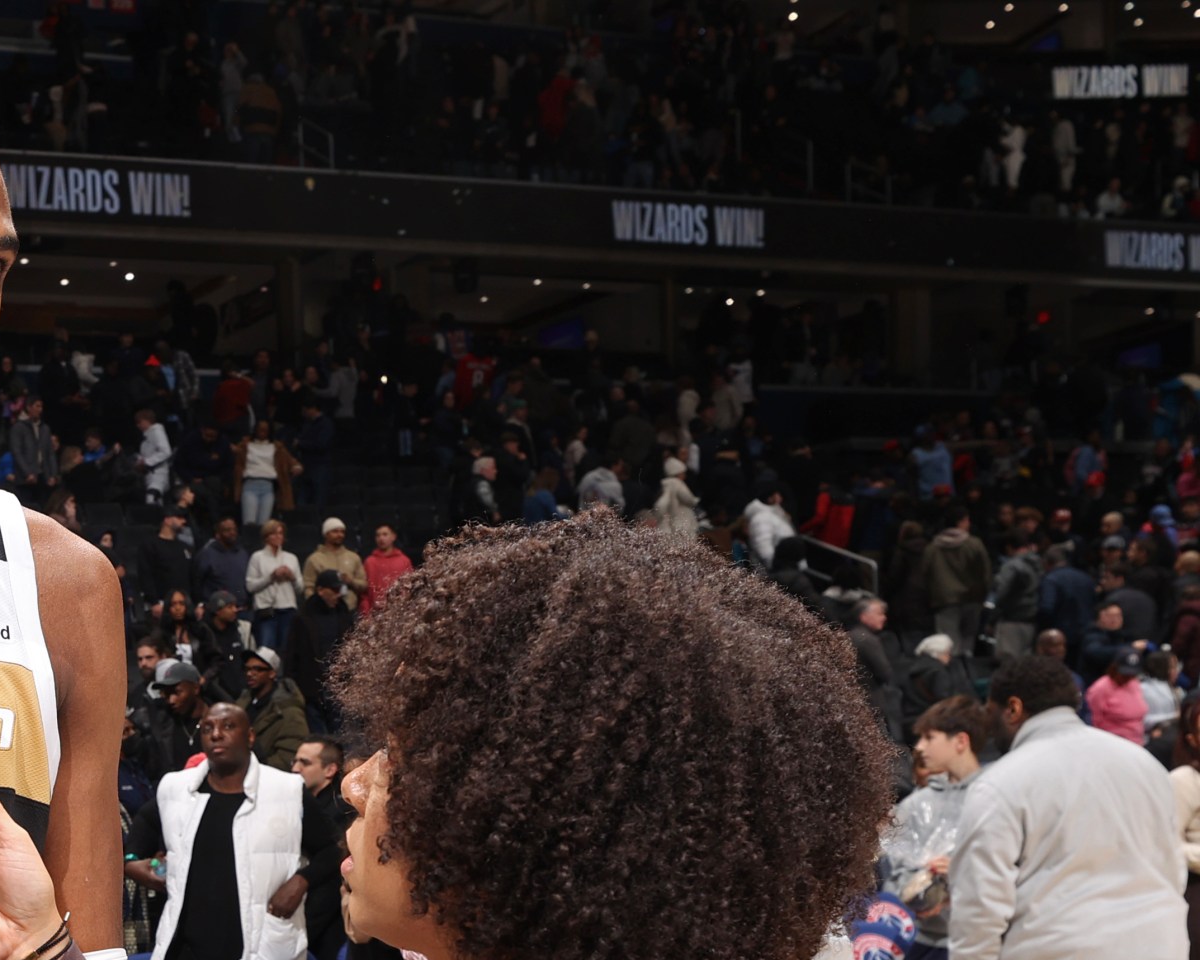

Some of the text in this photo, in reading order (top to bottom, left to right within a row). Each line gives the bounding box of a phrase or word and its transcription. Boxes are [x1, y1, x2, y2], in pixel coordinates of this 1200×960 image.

[1052, 63, 1188, 99] WIZARDS WIN!
[1, 164, 191, 217] WIZARDS WIN!
[612, 200, 764, 247] WIZARDS WIN!
[1104, 229, 1185, 271] WIZARDS
